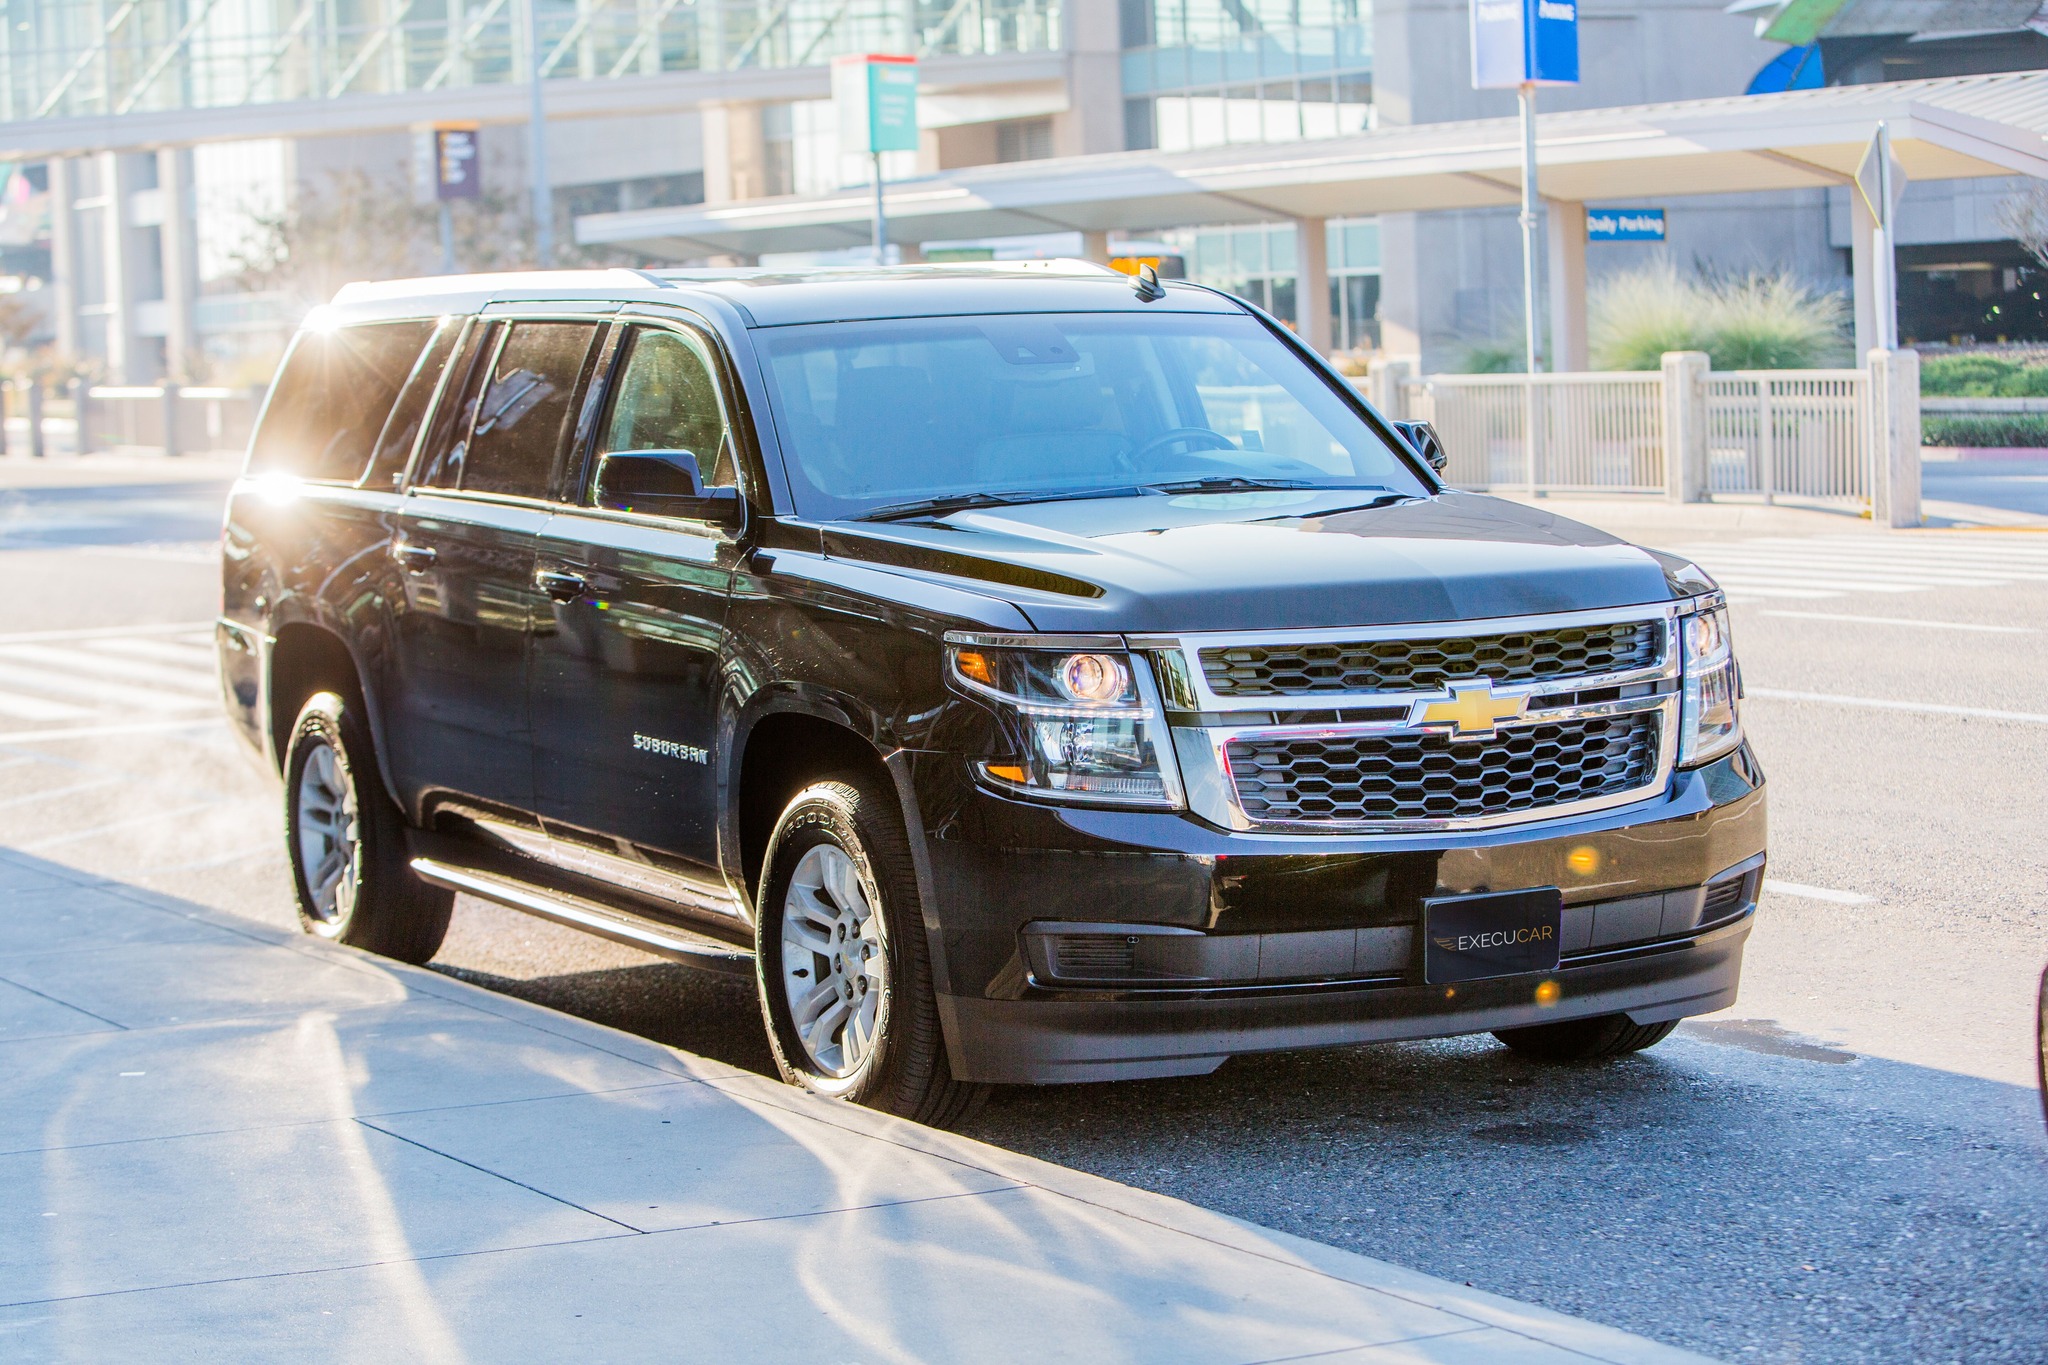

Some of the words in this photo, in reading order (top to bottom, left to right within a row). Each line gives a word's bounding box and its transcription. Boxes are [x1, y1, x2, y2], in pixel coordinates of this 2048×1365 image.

[1587, 216, 1616, 235] Daily
[1619, 215, 1664, 235] Parking
[633, 734, 708, 765] SUBURBAN
[1458, 925, 1553, 951] EXECUCAR
